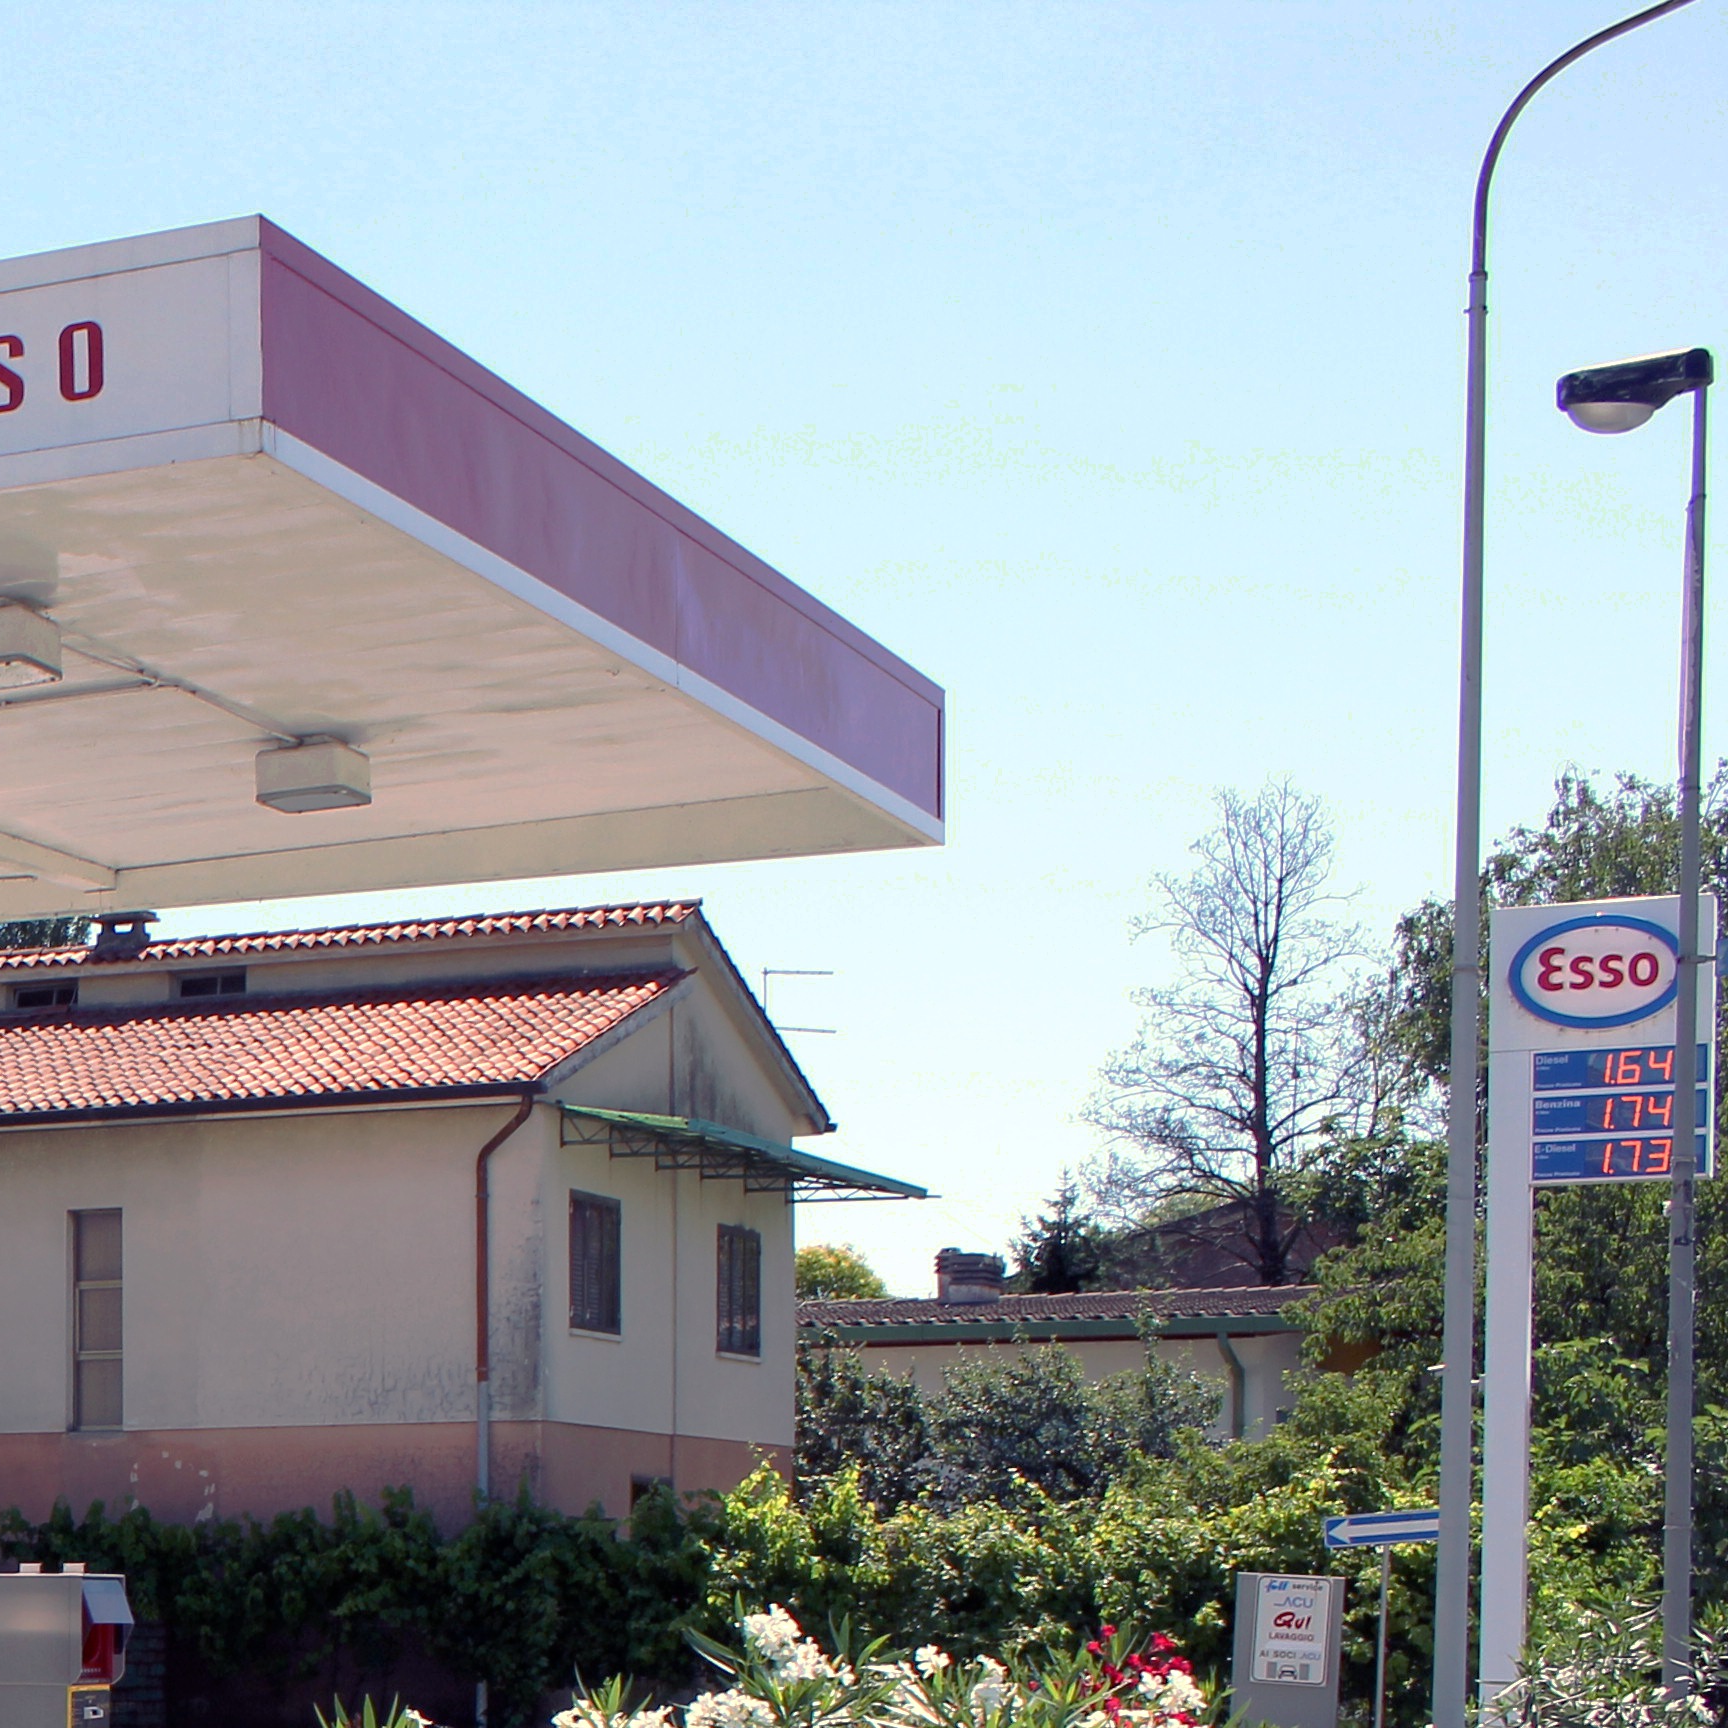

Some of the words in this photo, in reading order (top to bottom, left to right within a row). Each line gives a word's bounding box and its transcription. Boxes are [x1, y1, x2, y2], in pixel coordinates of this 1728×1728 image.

[1537, 946, 1659, 992] Esso
[1535, 1055, 1568, 1066] Diesel
[1535, 1099, 1581, 1110] Benzina
[1534, 1143, 1576, 1154] E-Diesel
[1268, 1632, 1315, 1642] LAVAGGIO
[1272, 1650, 1296, 1659] SOCI
